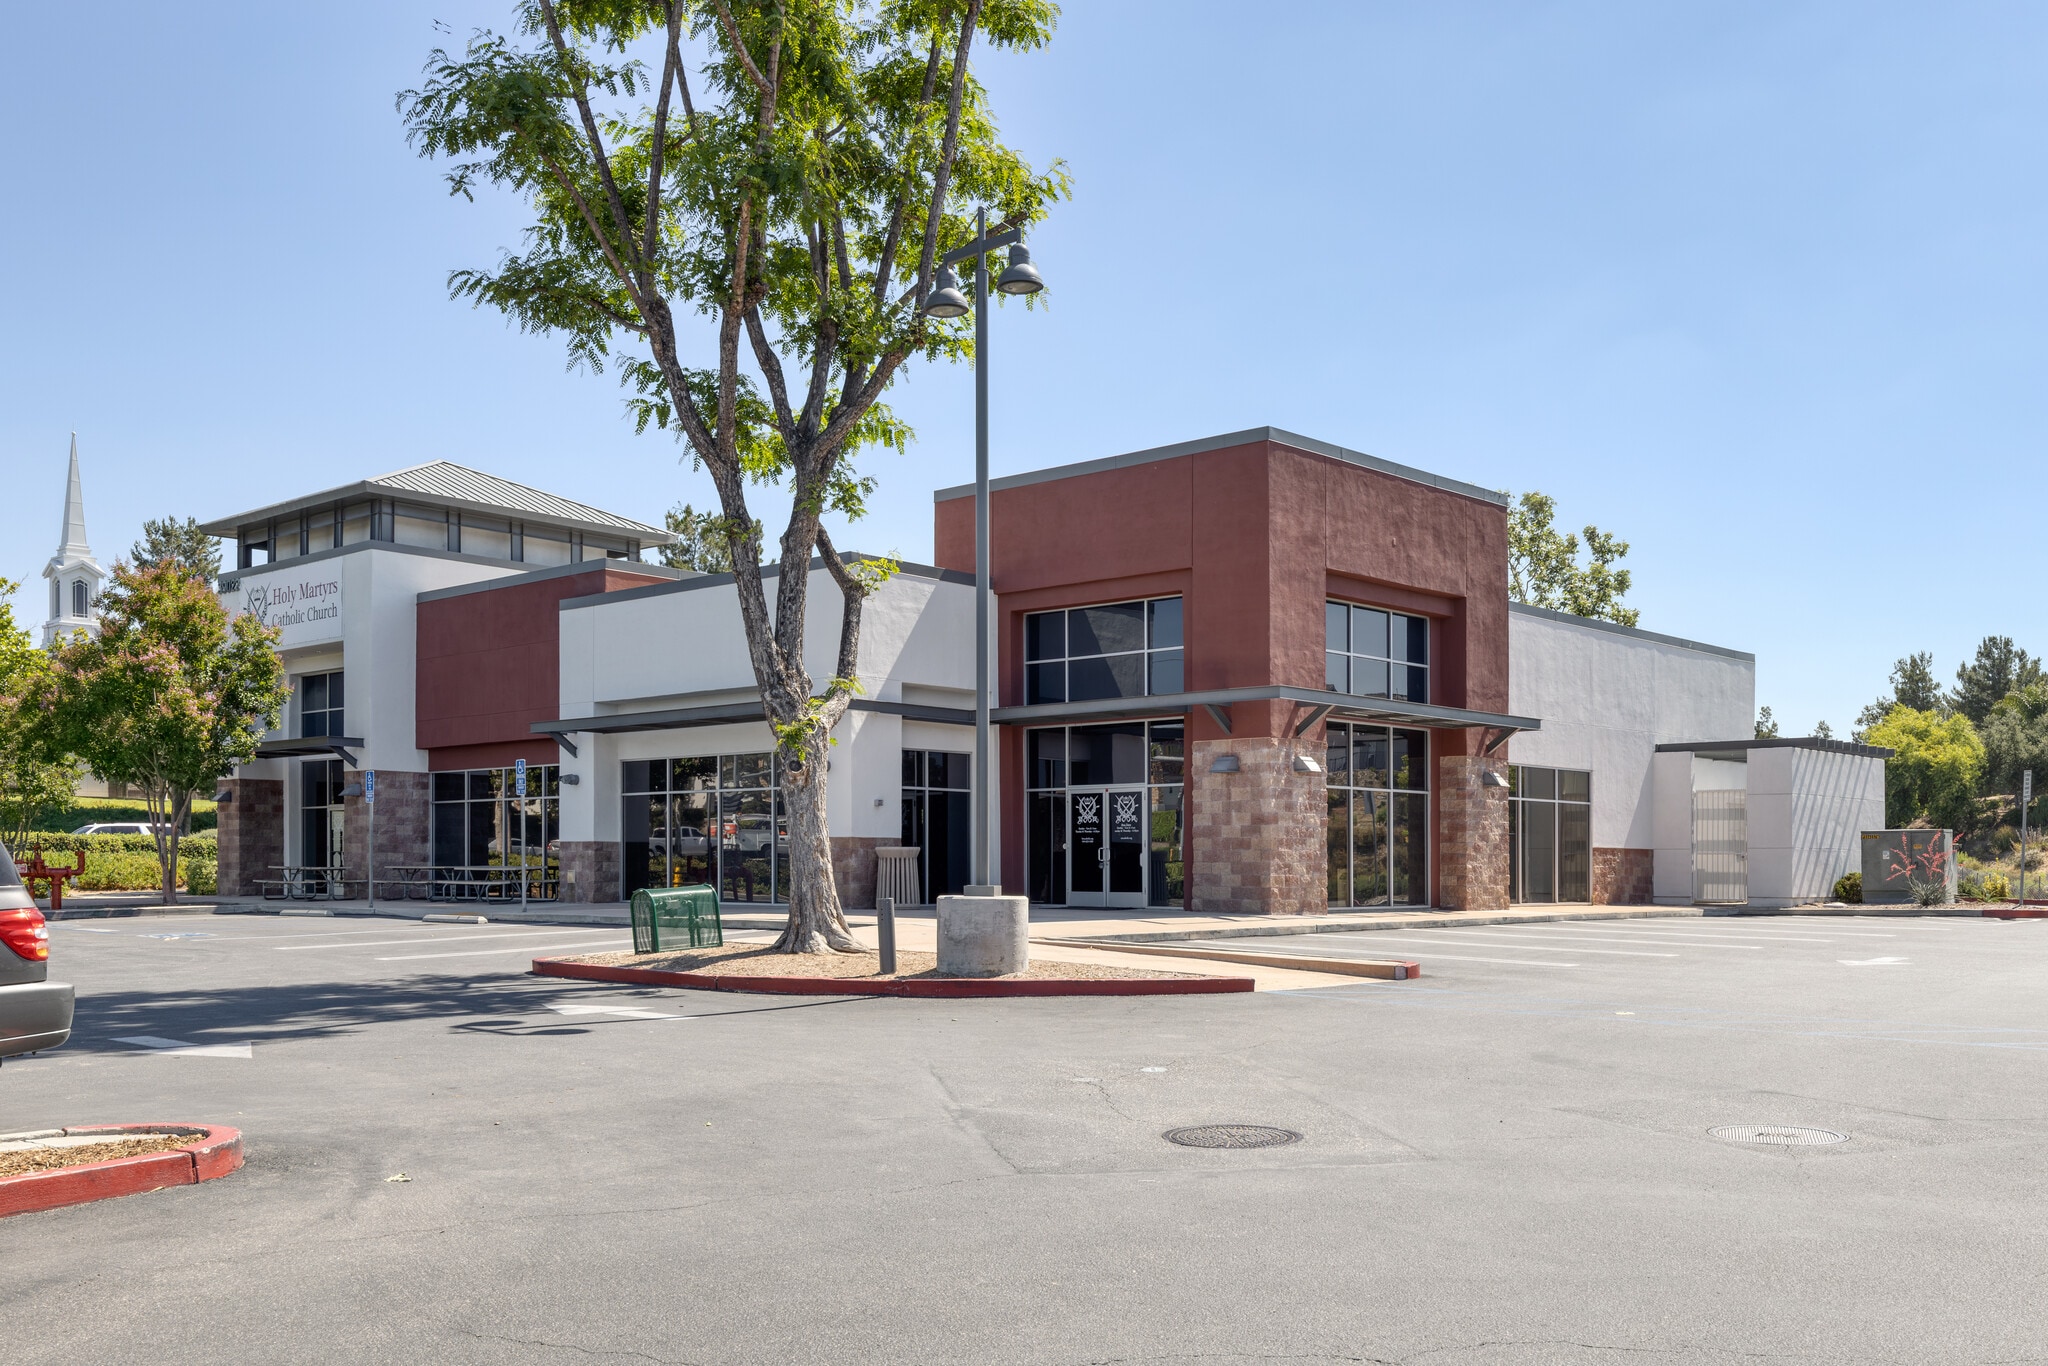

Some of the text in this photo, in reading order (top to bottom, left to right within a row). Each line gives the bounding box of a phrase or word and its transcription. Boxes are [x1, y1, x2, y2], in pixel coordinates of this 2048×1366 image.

[273, 580, 338, 609] Holy Martyrs
[272, 602, 338, 627] Catholic Church
